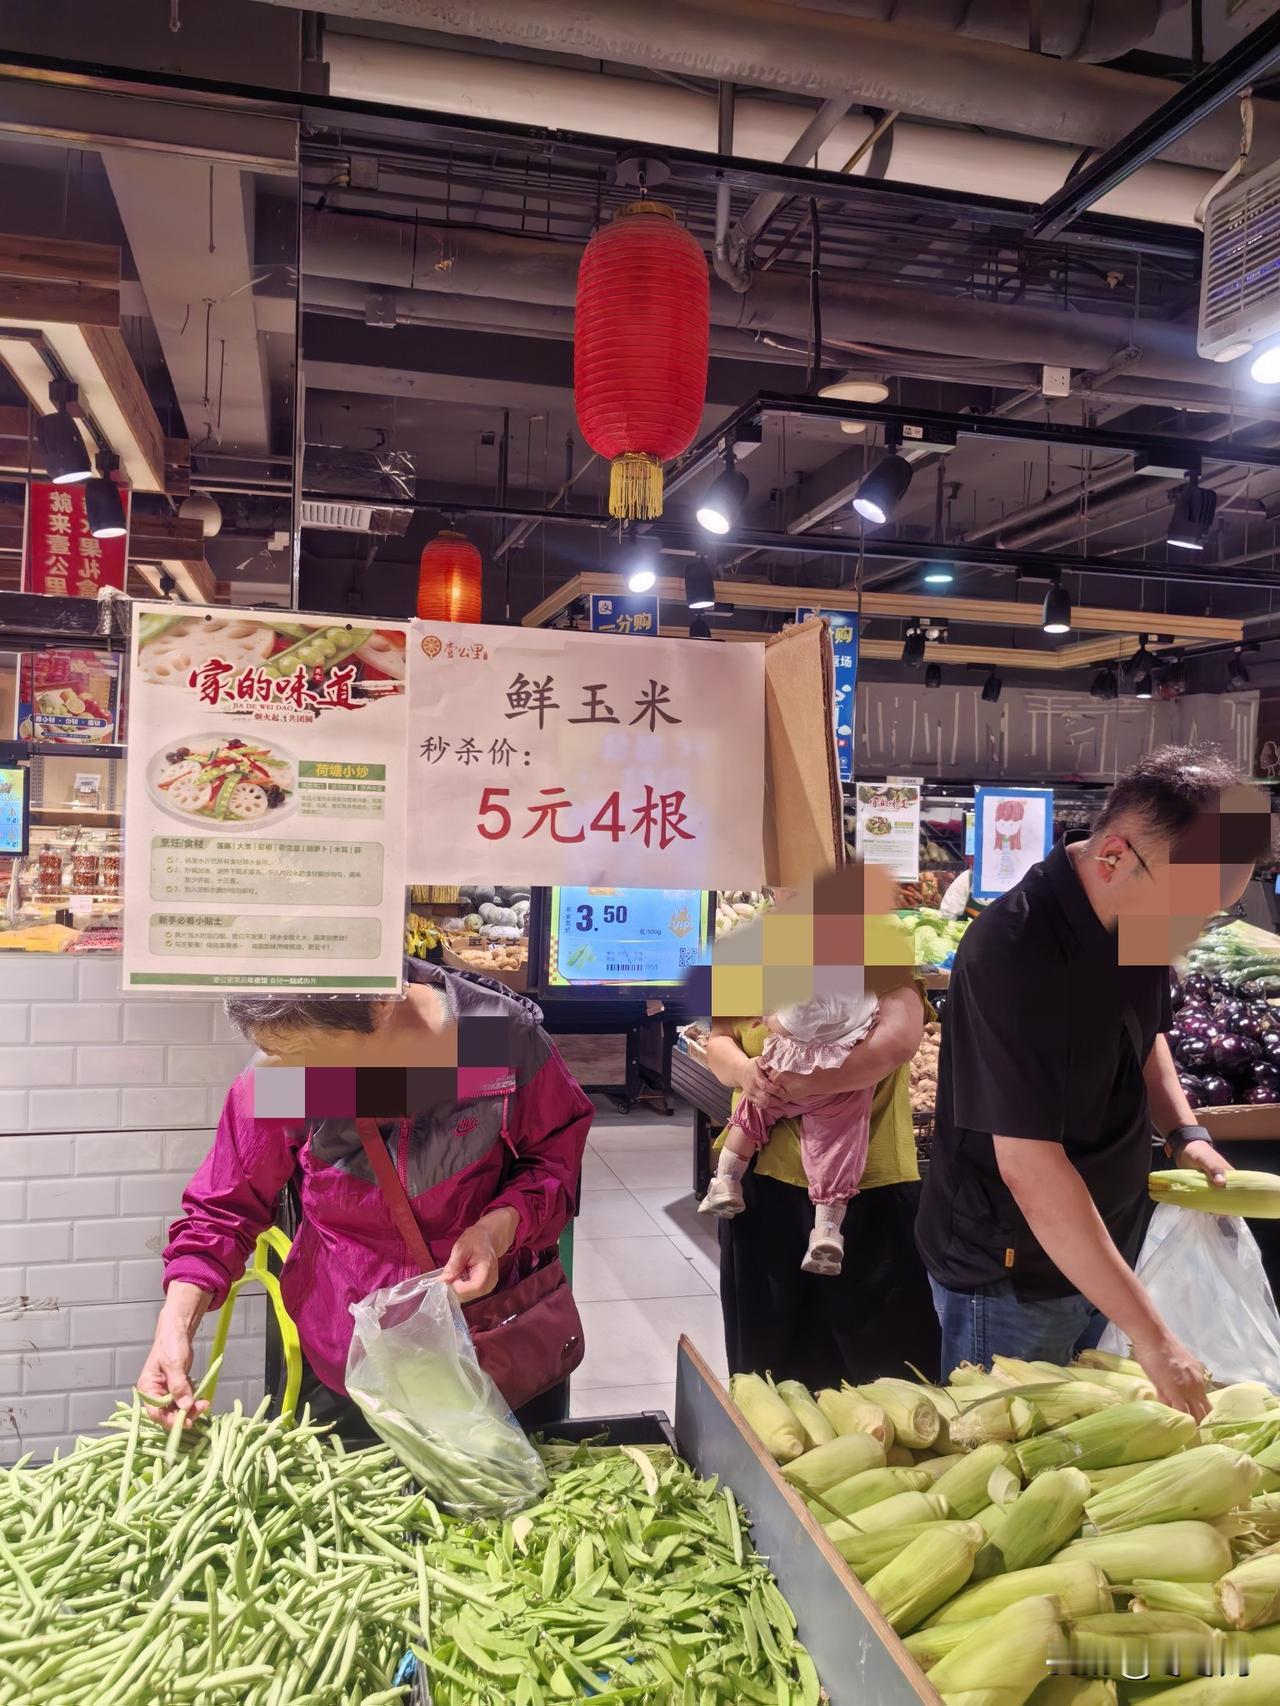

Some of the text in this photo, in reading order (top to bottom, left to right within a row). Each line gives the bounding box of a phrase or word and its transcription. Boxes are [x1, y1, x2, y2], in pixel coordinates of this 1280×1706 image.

[598, 612, 652, 633] 一分购
[189, 659, 367, 711] 家的味道
[276, 704, 294, 712] DAO
[504, 672, 683, 732] 鲜玉米
[315, 763, 369, 778] 荷塘小炒
[476, 784, 696, 850] 5元4根
[160, 838, 205, 849] 烹饪/食材
[158, 915, 223, 926] 新手必看小贴士
